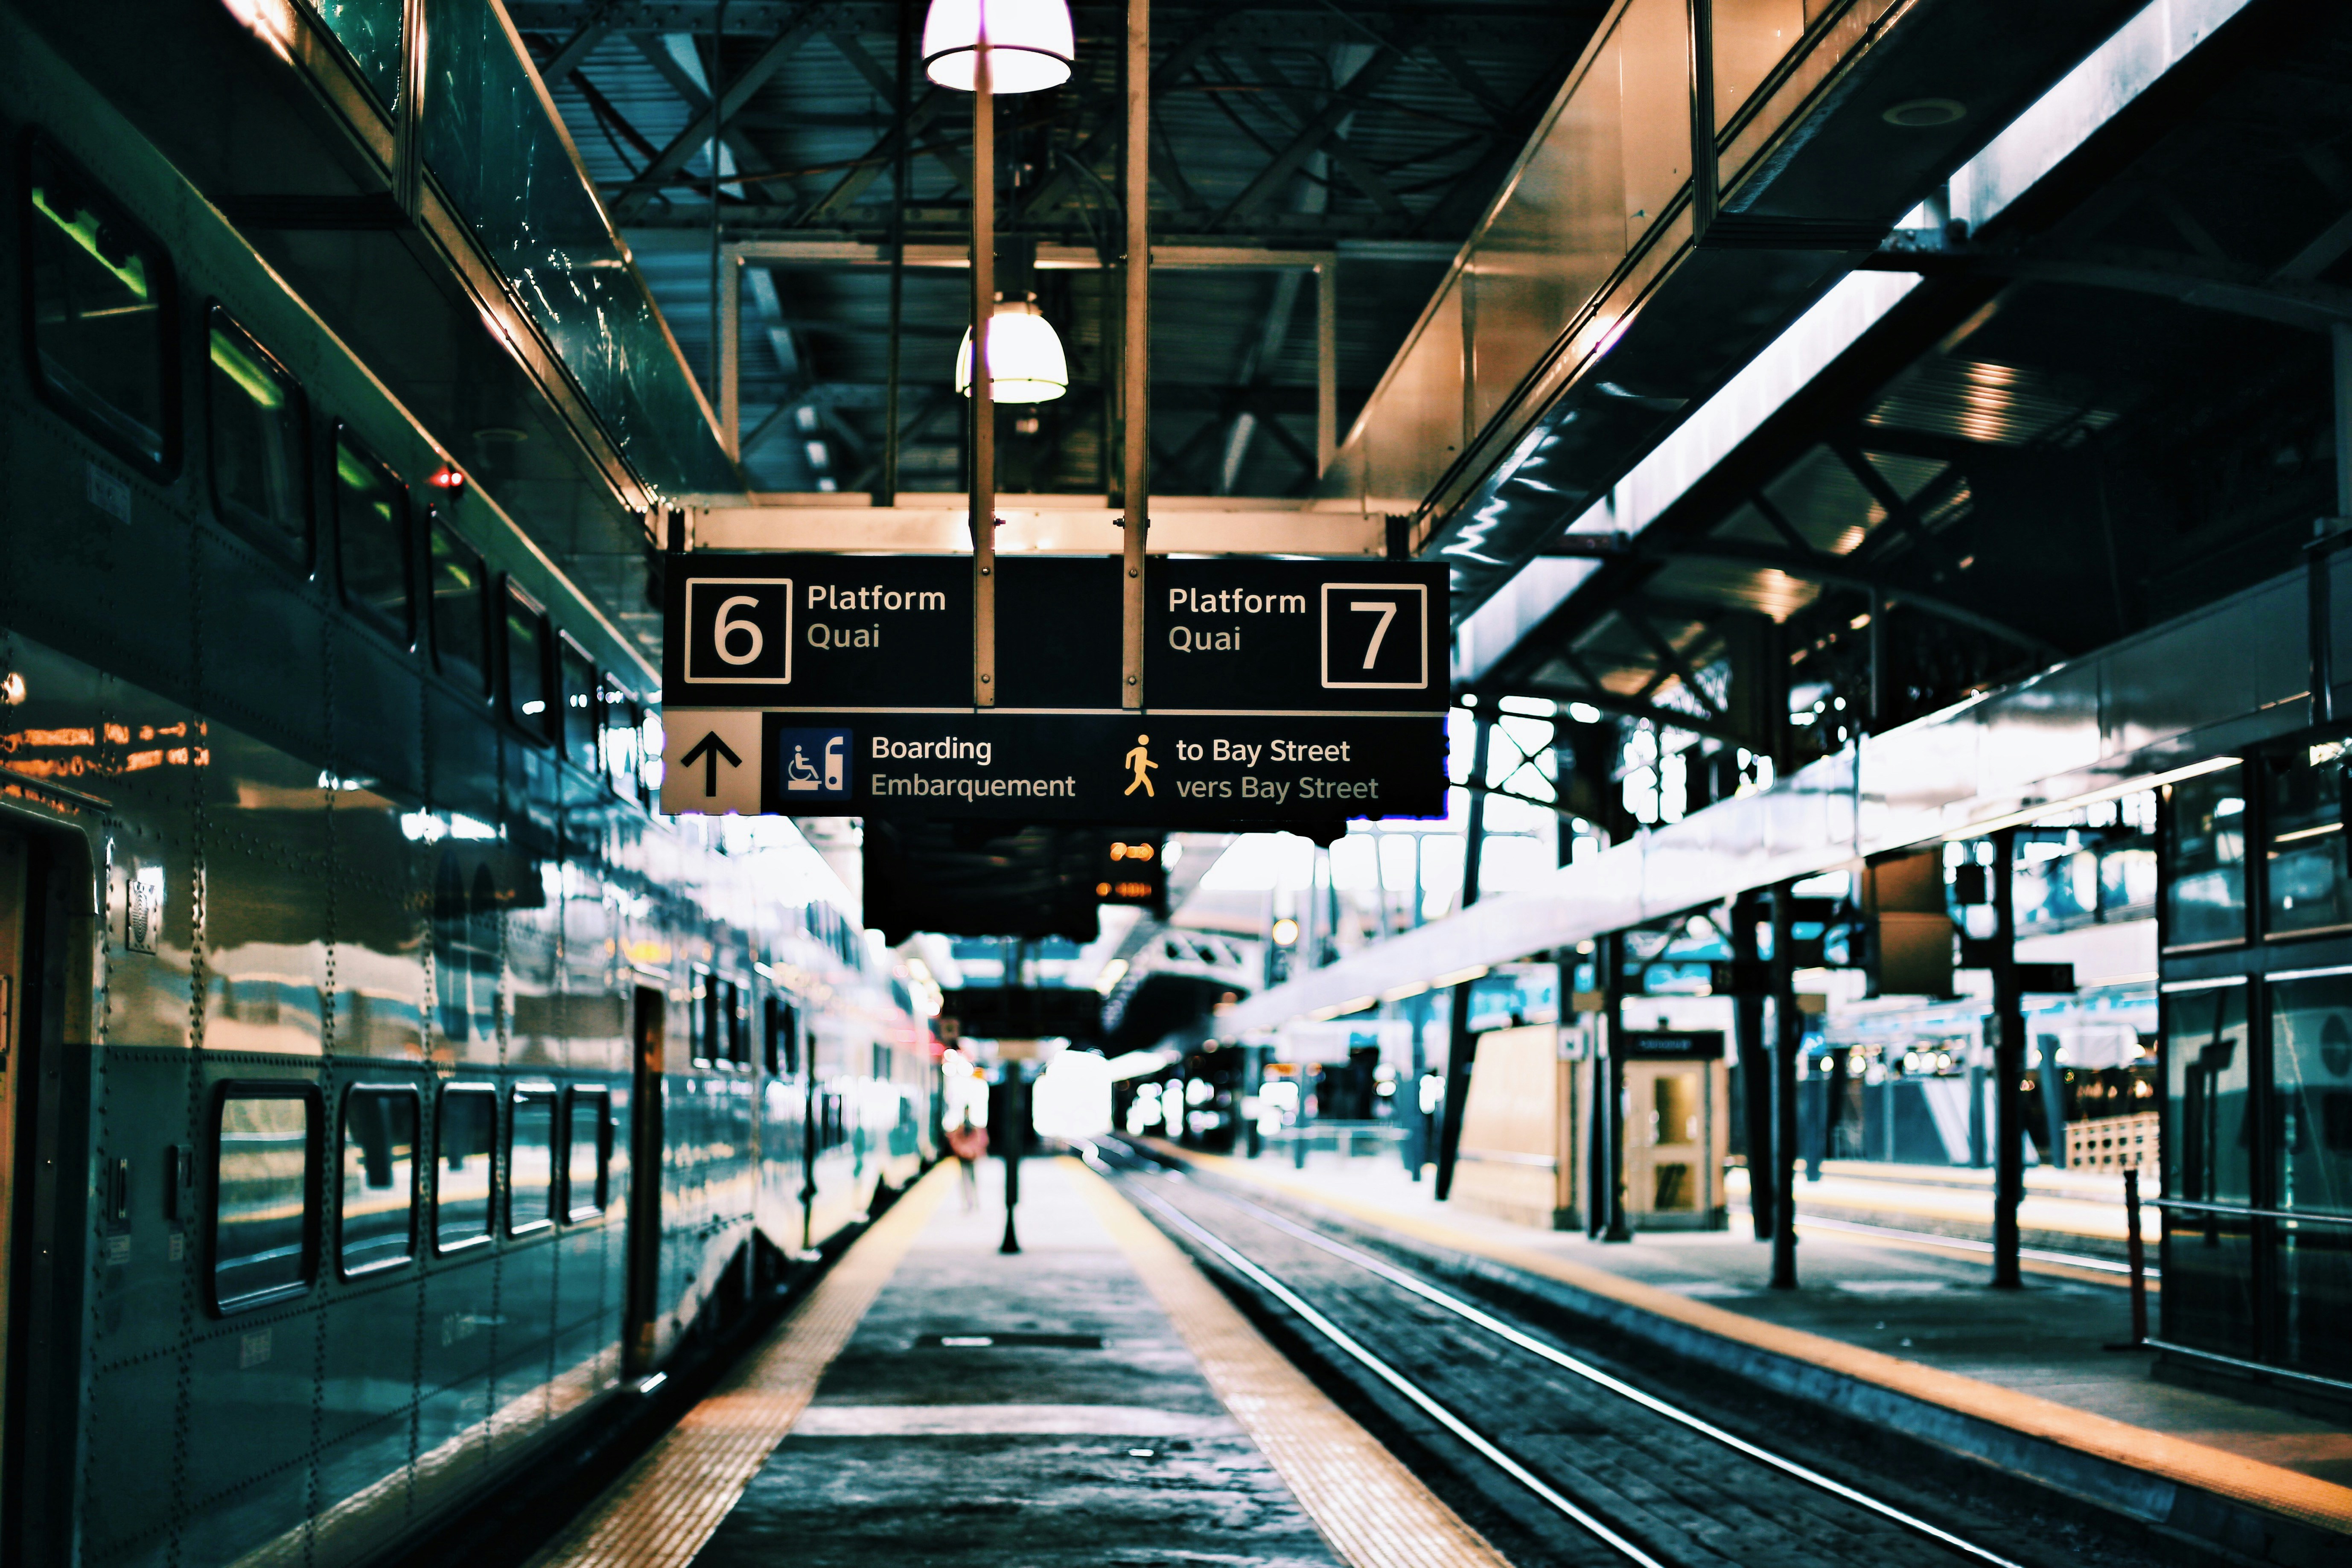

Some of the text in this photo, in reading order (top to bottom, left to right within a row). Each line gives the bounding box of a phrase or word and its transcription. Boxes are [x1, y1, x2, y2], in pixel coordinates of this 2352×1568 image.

[809, 585, 945, 610] Platform
[1170, 588, 1305, 613] Platform
[714, 596, 763, 665] 6
[808, 624, 879, 650] Quai
[1169, 626, 1240, 653] Quai
[1351, 602, 1396, 669] 7
[873, 737, 991, 765] Boarding
[1176, 739, 1350, 767] to Bay Street
[872, 773, 1075, 801] Embarquement
[1177, 776, 1378, 804] vers Bay Street
